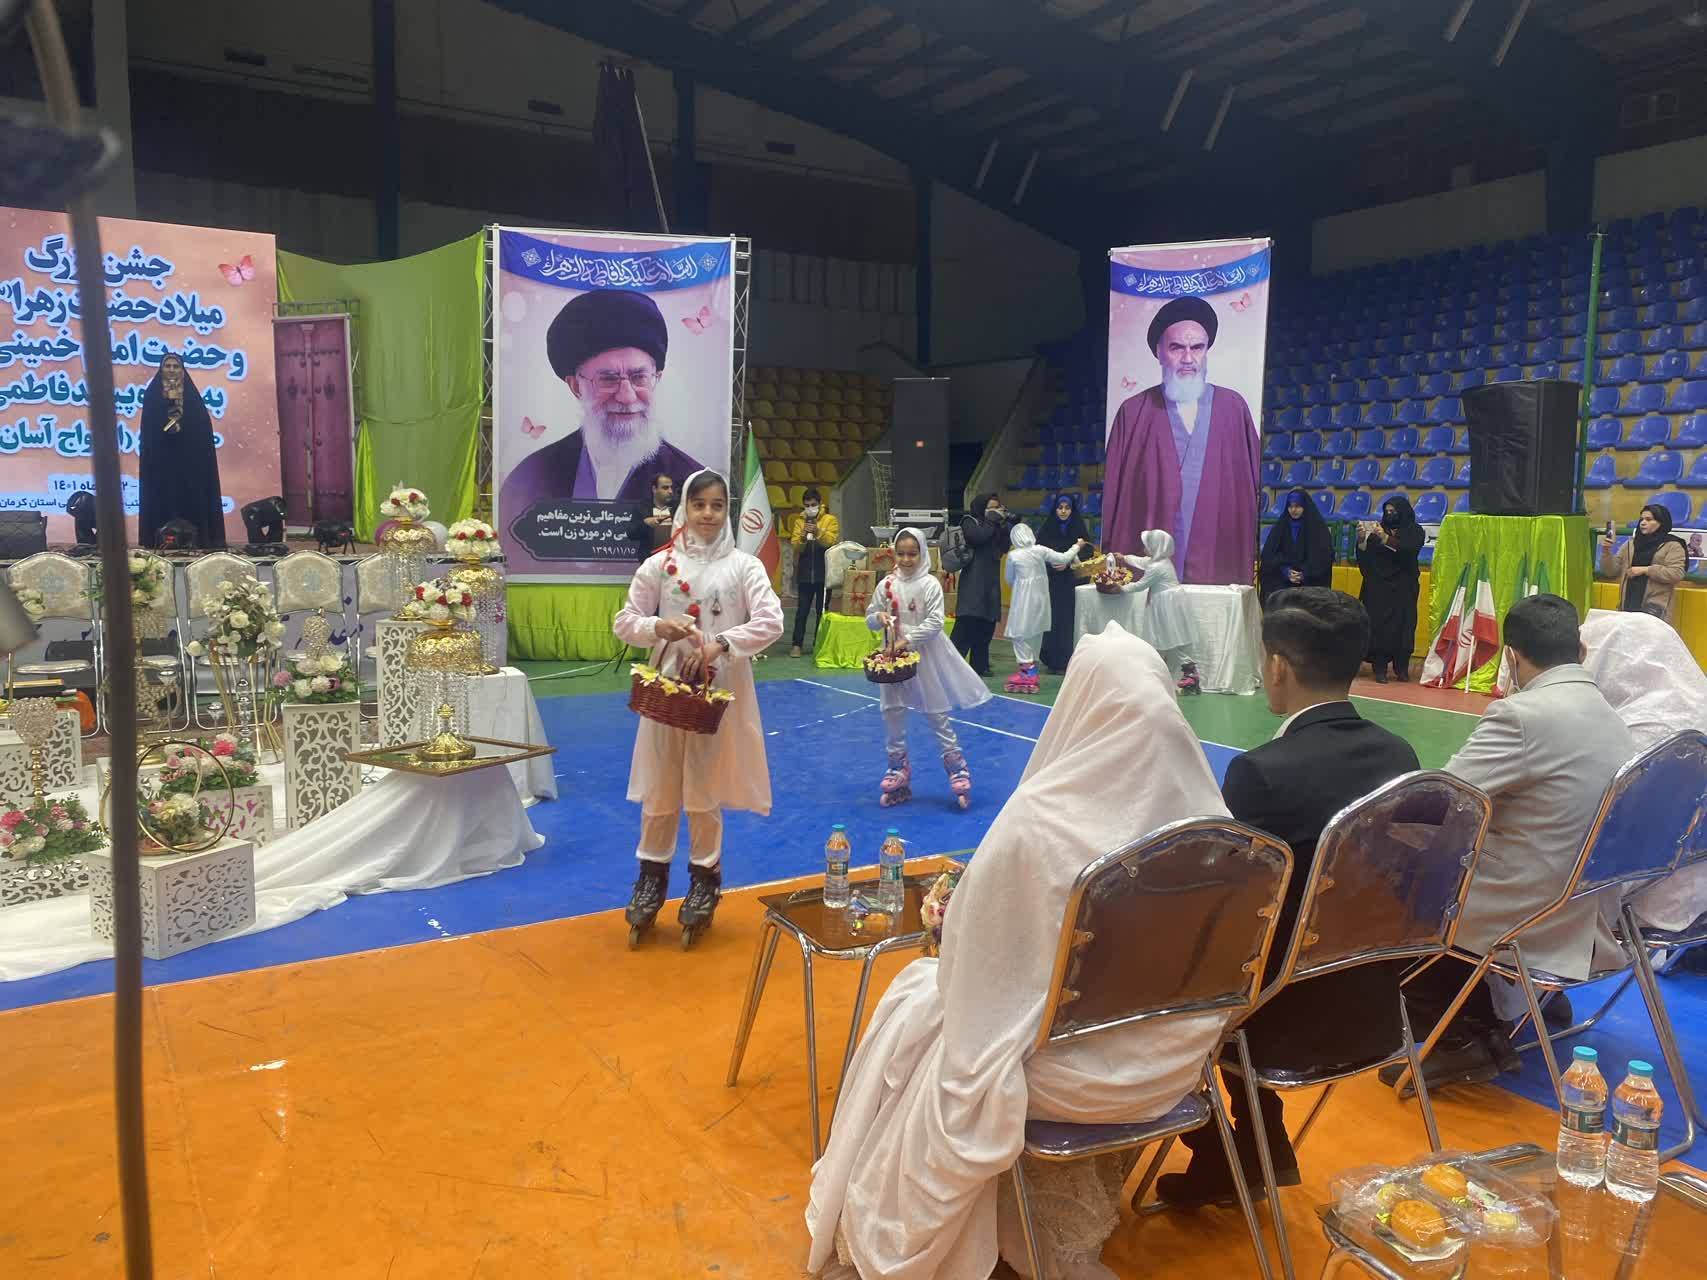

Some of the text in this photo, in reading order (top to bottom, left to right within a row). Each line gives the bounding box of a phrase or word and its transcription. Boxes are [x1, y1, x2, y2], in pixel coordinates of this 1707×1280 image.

[27, 236, 172, 287] جشن رگ
[12, 280, 223, 332] میلاد حضت زهرا
[111, 333, 138, 361] ام
[142, 338, 227, 364] حضت
[0, 417, 52, 450] آسان
[29, 498, 57, 508] استان
[536, 509, 568, 522] مفاهیم
[565, 528, 577, 540] زن
[579, 528, 599, 541] مورد
[600, 528, 612, 541] در
